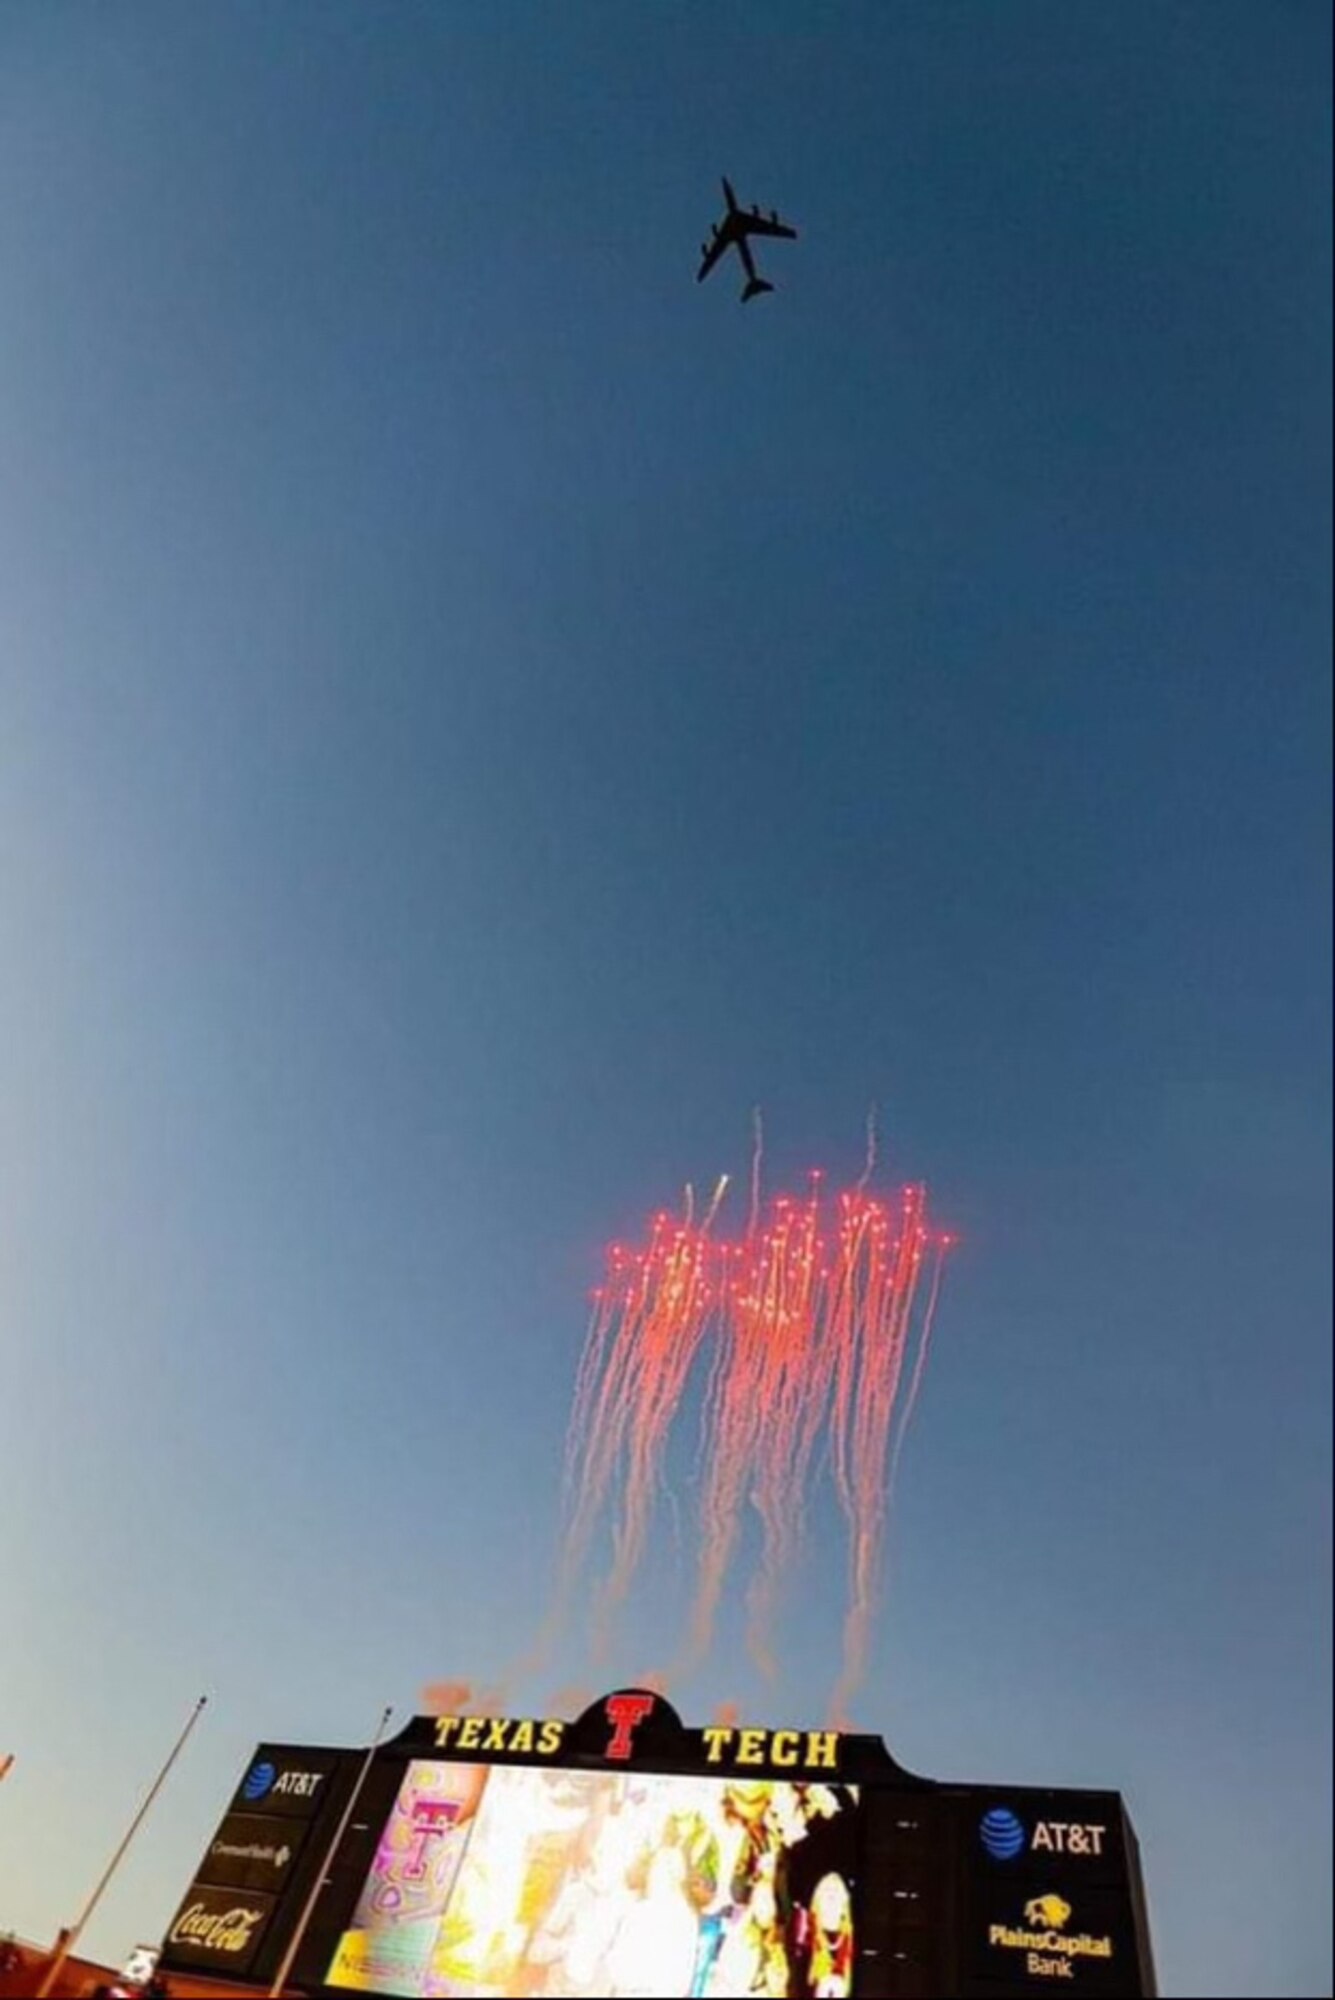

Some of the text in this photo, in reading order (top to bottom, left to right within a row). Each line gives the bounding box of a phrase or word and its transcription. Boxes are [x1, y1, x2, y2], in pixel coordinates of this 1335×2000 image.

[434, 1717, 565, 1755] TEXAS
[703, 1728, 838, 1768] TECH
[273, 1772, 323, 1798] AT&T
[1032, 1823, 1106, 1855] AT&T
[989, 1924, 1112, 1957] PlainsCapital
[1027, 1953, 1073, 1978] Bank
